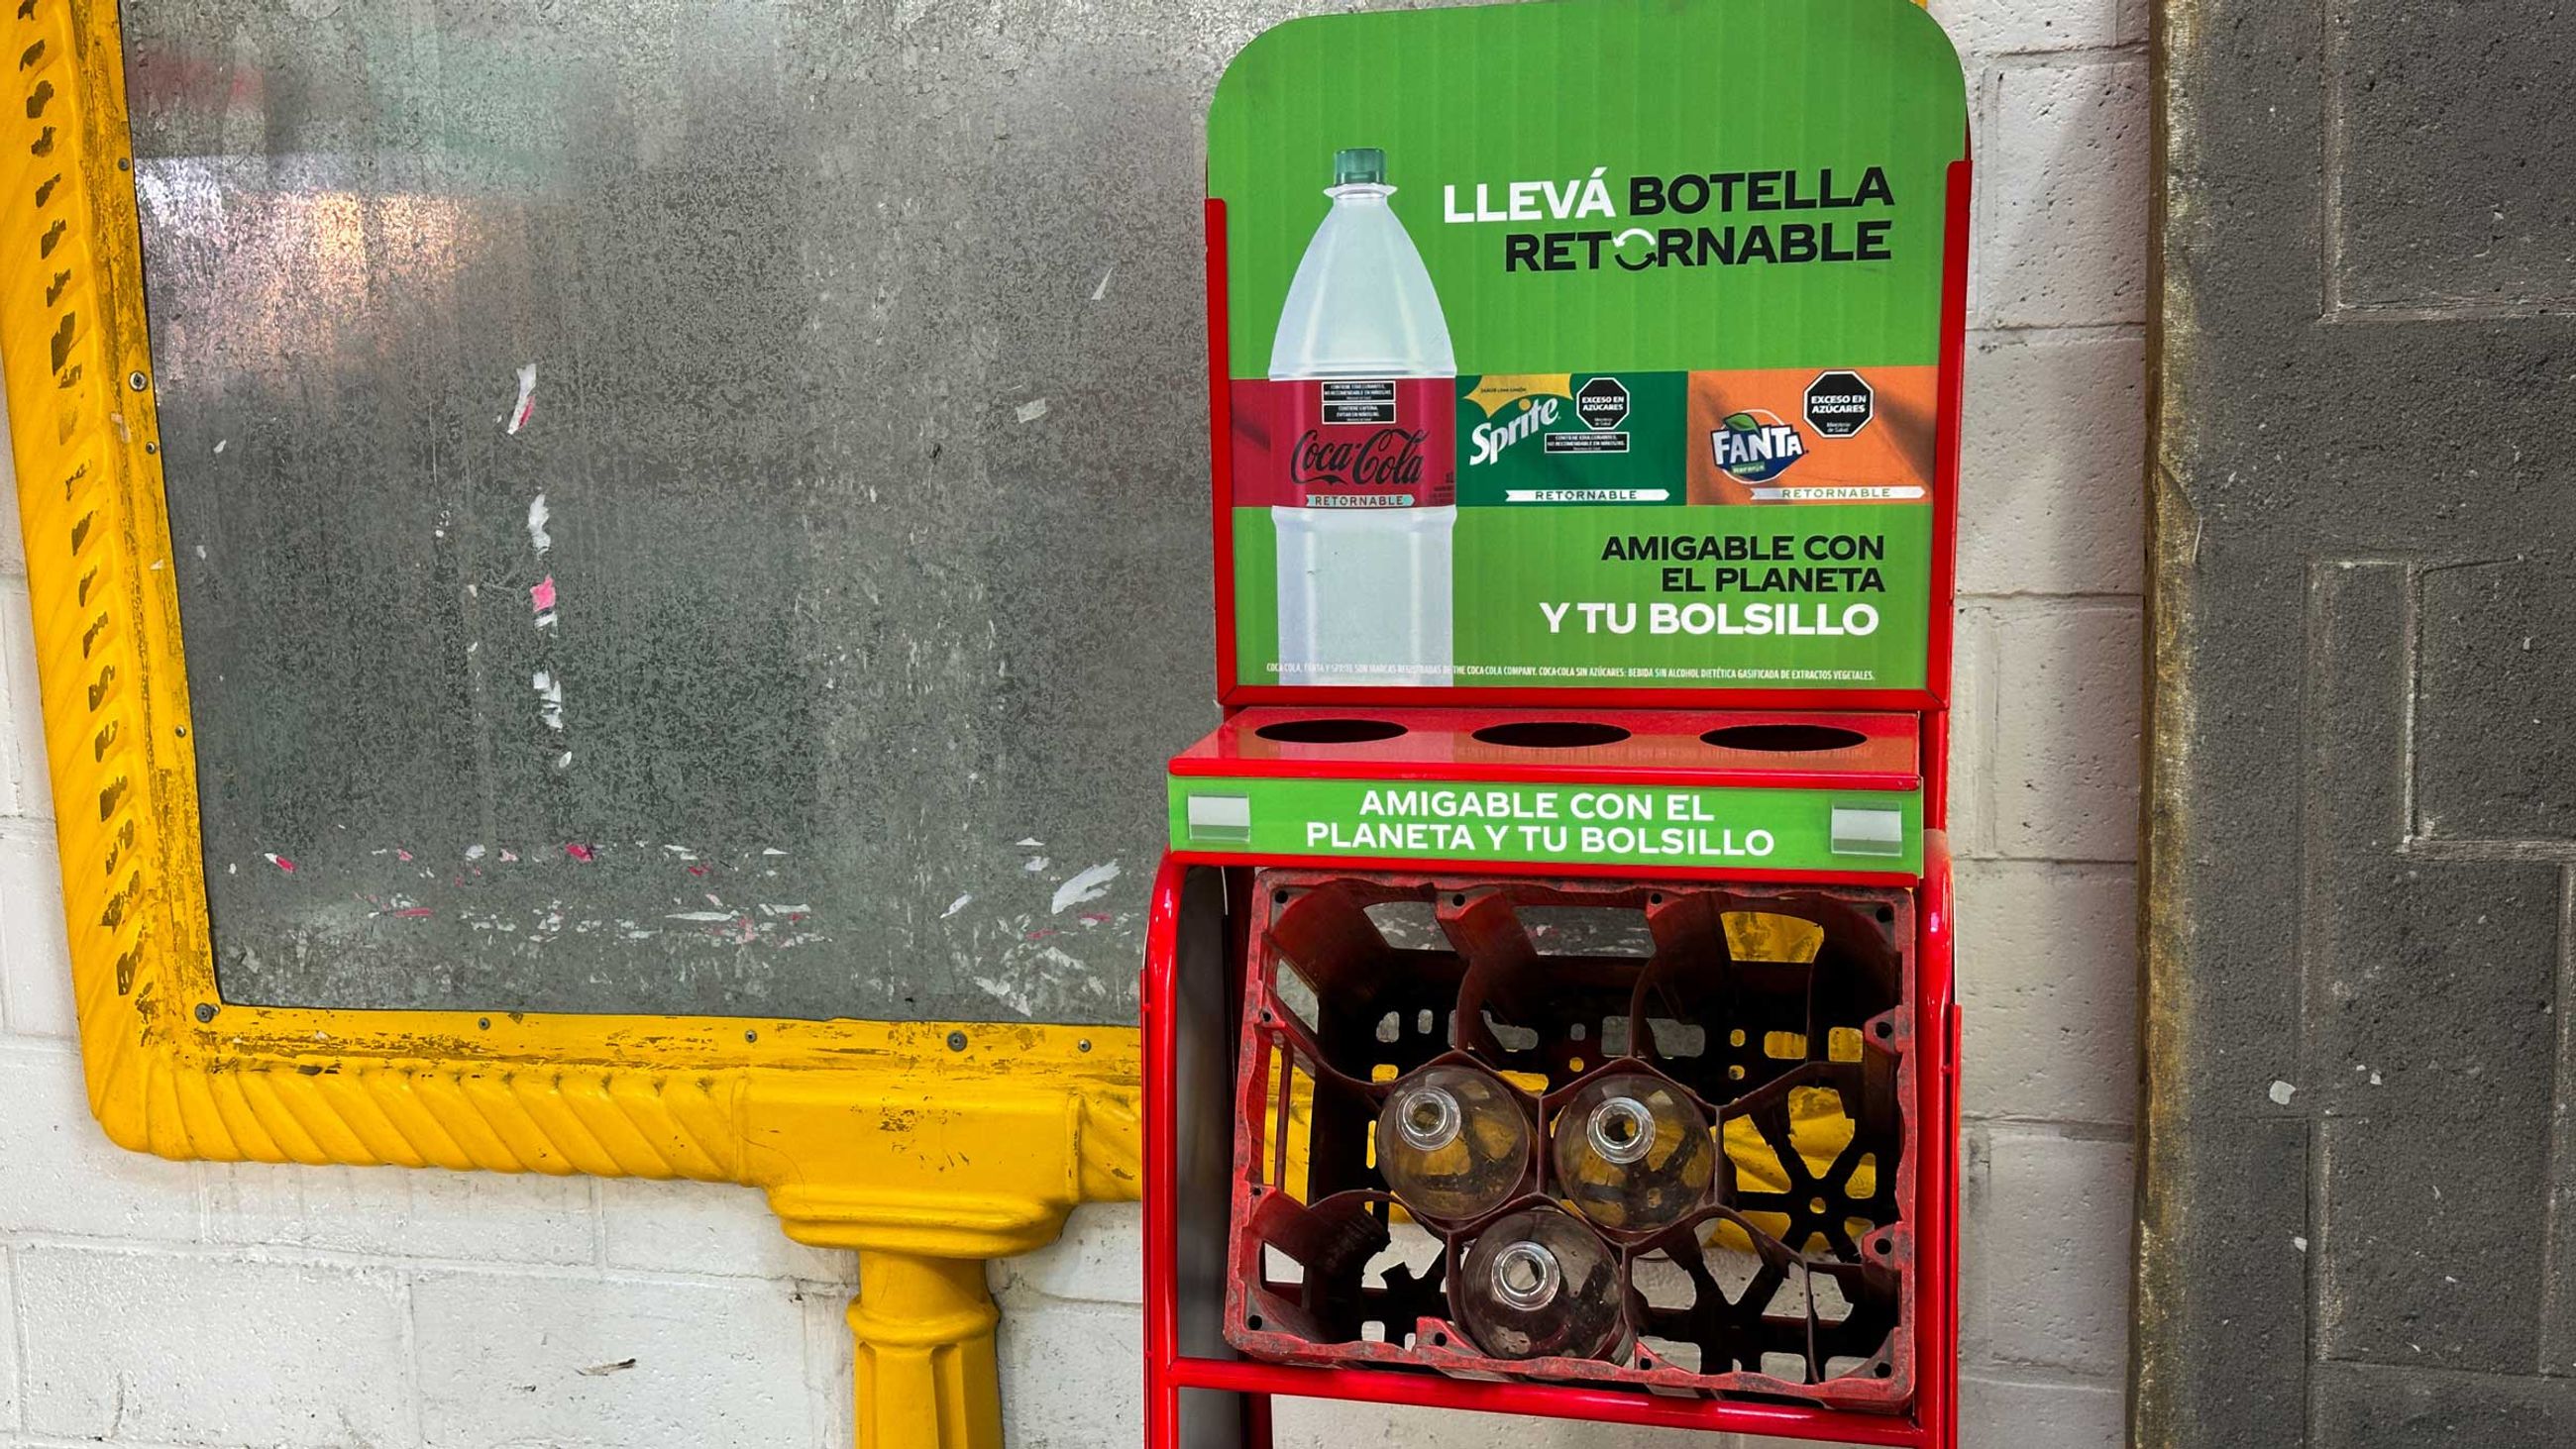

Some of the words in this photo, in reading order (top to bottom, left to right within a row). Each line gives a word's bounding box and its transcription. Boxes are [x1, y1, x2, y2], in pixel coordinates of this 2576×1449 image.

[1445, 166, 1616, 223] LLEVÁ
[1630, 166, 1895, 216] BOTELLA
[1505, 220, 1892, 272] RETORNABLE
[1582, 402, 1624, 411] AZÚCARES
[1811, 395, 1851, 404] EXCESO
[1852, 394, 1867, 403] EN
[1811, 402, 1867, 414] AZÚCARES
[1469, 397, 1559, 466] Sprite
[1290, 428, 1431, 485] Coca-Cola
[1315, 496, 1404, 506] RETORNABLE
[1535, 490, 1638, 500] RETORNABLE
[1781, 488, 1891, 498] RETORNABLE
[1601, 536, 1794, 561] AMIGABLE
[1803, 535, 1884, 561] CON
[1662, 568, 1706, 592] EL
[1715, 568, 1885, 592] PLANETA
[1539, 602, 1570, 634] Y
[1577, 602, 1636, 634] TU
[1650, 603, 1879, 635] BOLSILLO
[1628, 667, 1654, 677] BEBIDA
[1655, 668, 1666, 677] SIN
[1667, 668, 1699, 678] ALCOHOL
[1700, 667, 1736, 678] DIETÉTICA
[1737, 669, 1779, 679] GASIFICADA
[1780, 669, 1790, 679] DE
[1791, 669, 1832, 679] EXTRACTOS
[1833, 670, 1876, 680] VEGETALES.
[1359, 790, 1558, 818] AMIGABLE
[1569, 792, 1653, 820] CON
[1666, 794, 1715, 821] EL
[1306, 821, 1475, 850] PLANETA
[1484, 825, 1510, 851] Y
[1518, 825, 1567, 852] TU
[1581, 826, 1774, 857] BOLSILLO
